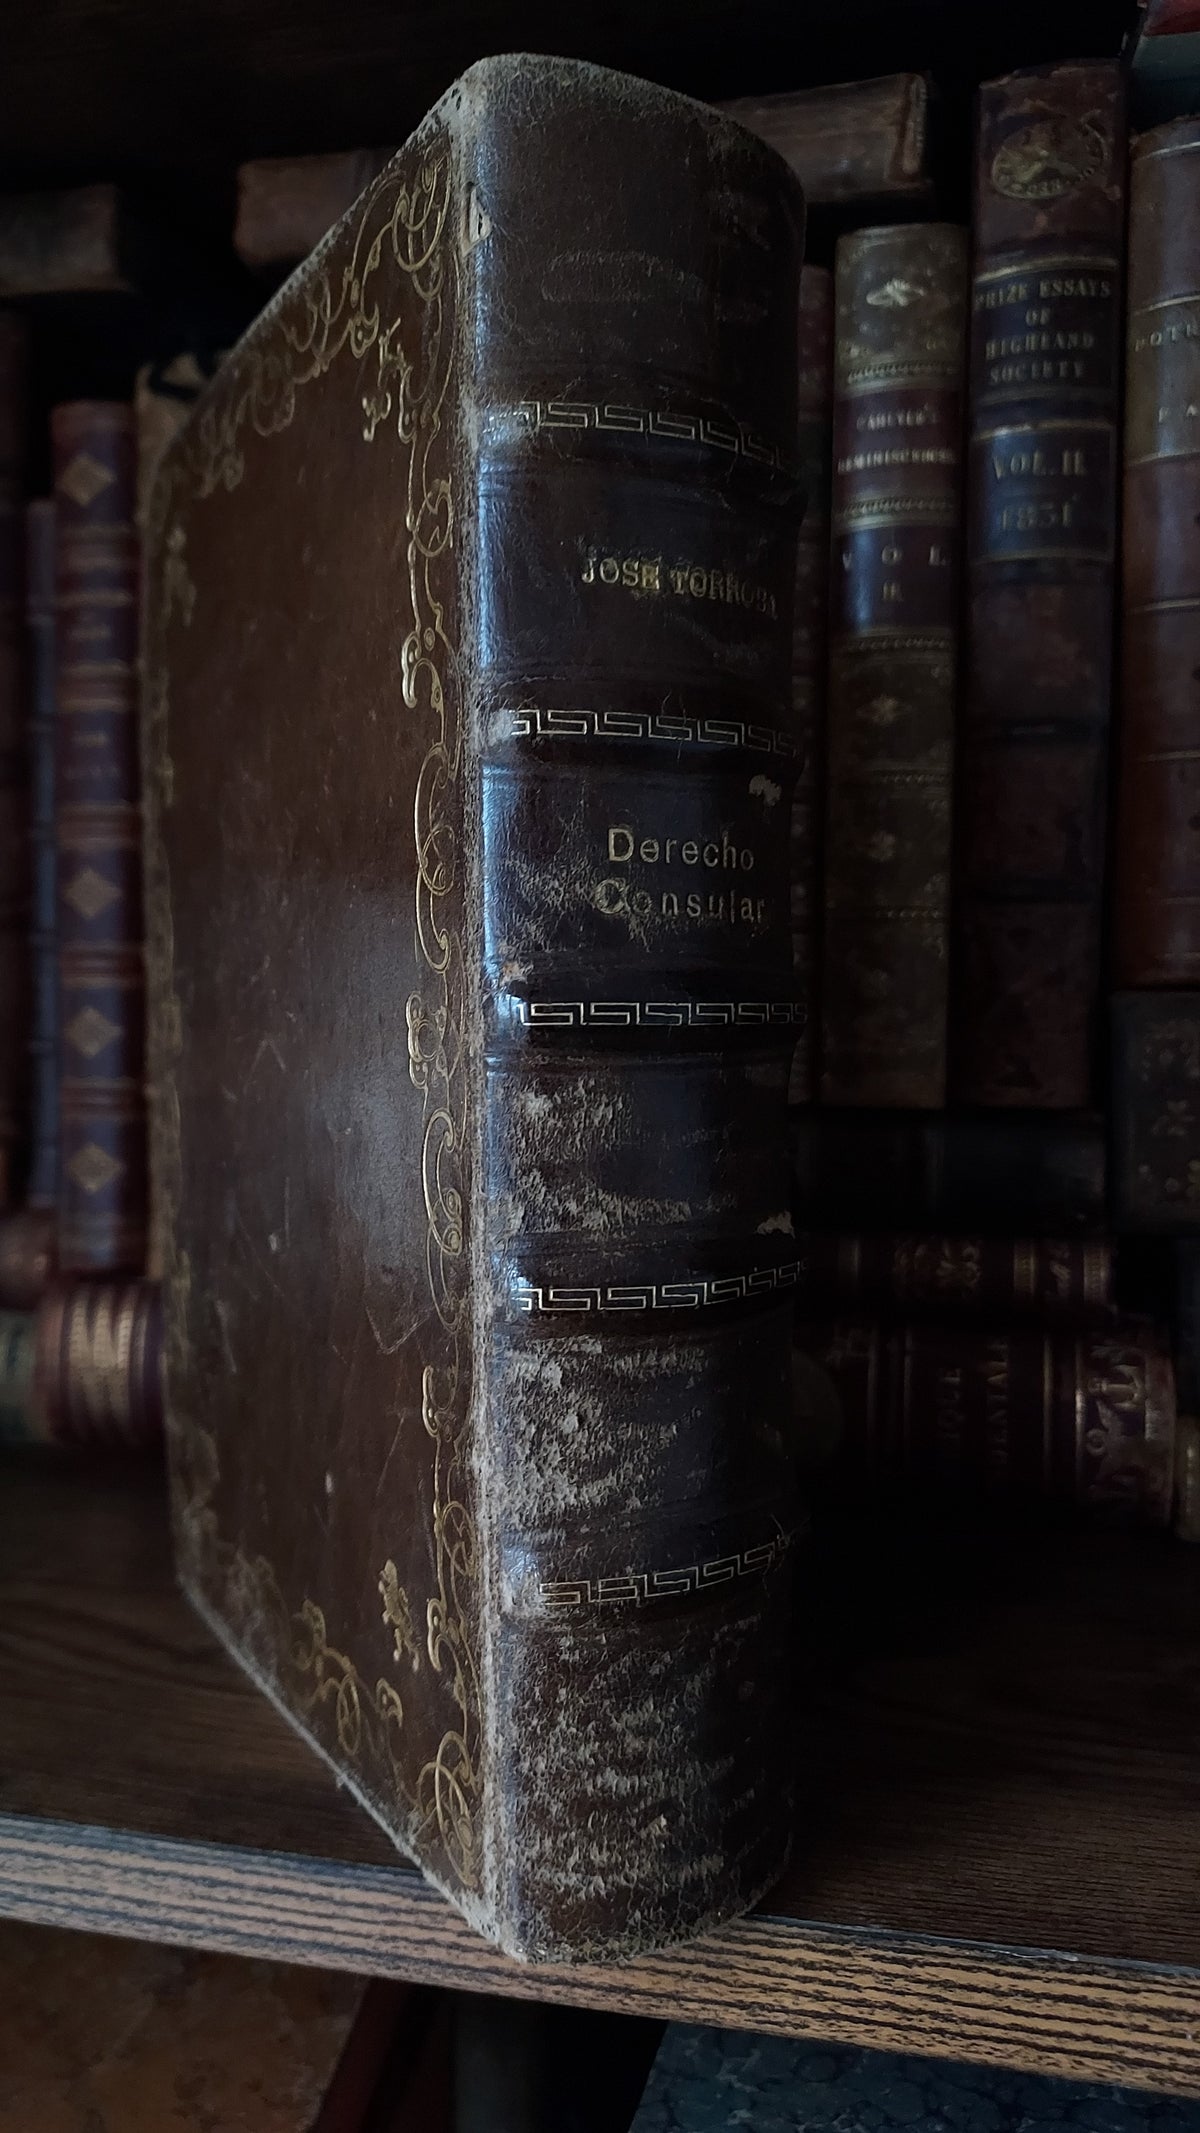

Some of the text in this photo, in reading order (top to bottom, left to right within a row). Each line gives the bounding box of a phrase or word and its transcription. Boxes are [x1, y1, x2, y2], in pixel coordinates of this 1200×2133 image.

[975, 279, 1111, 310] PRIZE ESSAYS
[1025, 307, 1052, 326] OF
[985, 331, 1096, 360] HIGHLAND
[989, 359, 1086, 384] SOCIETY
[608, 826, 754, 871] Derecho
[594, 878, 765, 924] Consular
